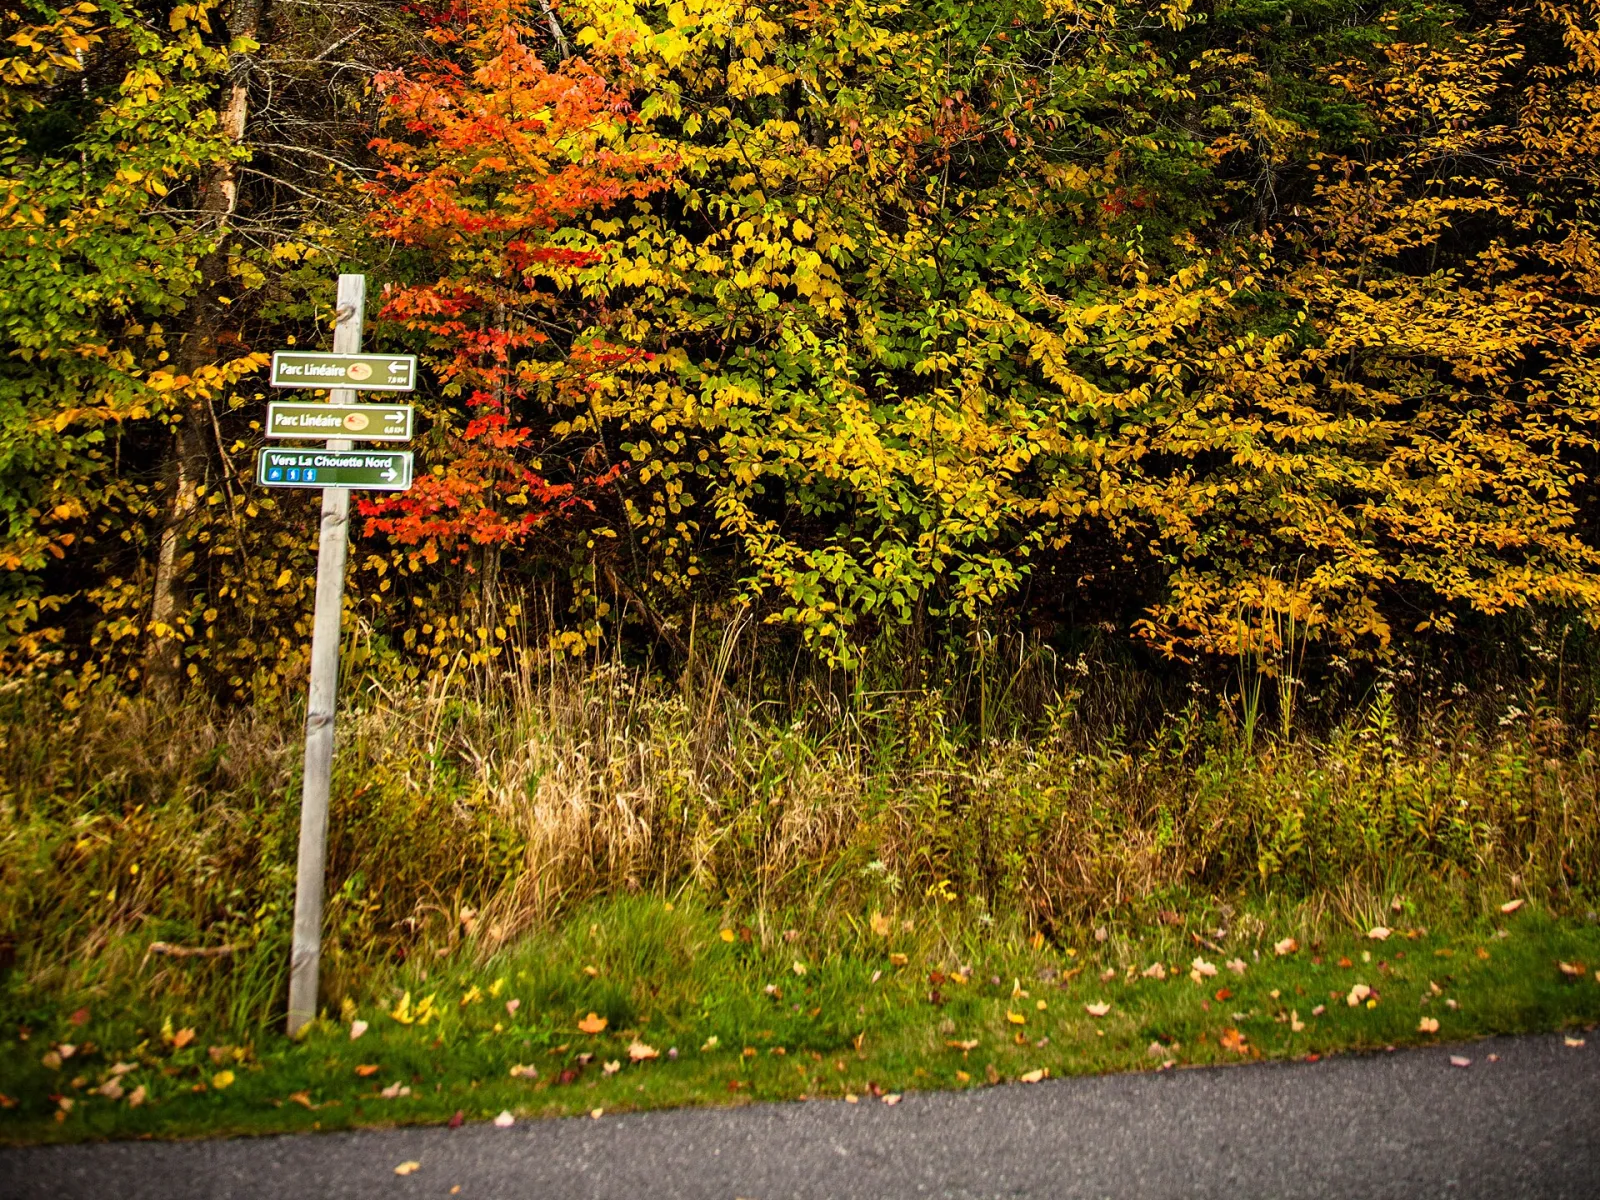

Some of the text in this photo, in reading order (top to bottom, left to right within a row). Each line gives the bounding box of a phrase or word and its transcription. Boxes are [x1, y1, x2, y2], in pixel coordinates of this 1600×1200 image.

[280, 362, 346, 377] Parc Linéaire
[275, 413, 342, 427] Parc Linéaire
[271, 455, 393, 468] Vers La Chouette Nord
